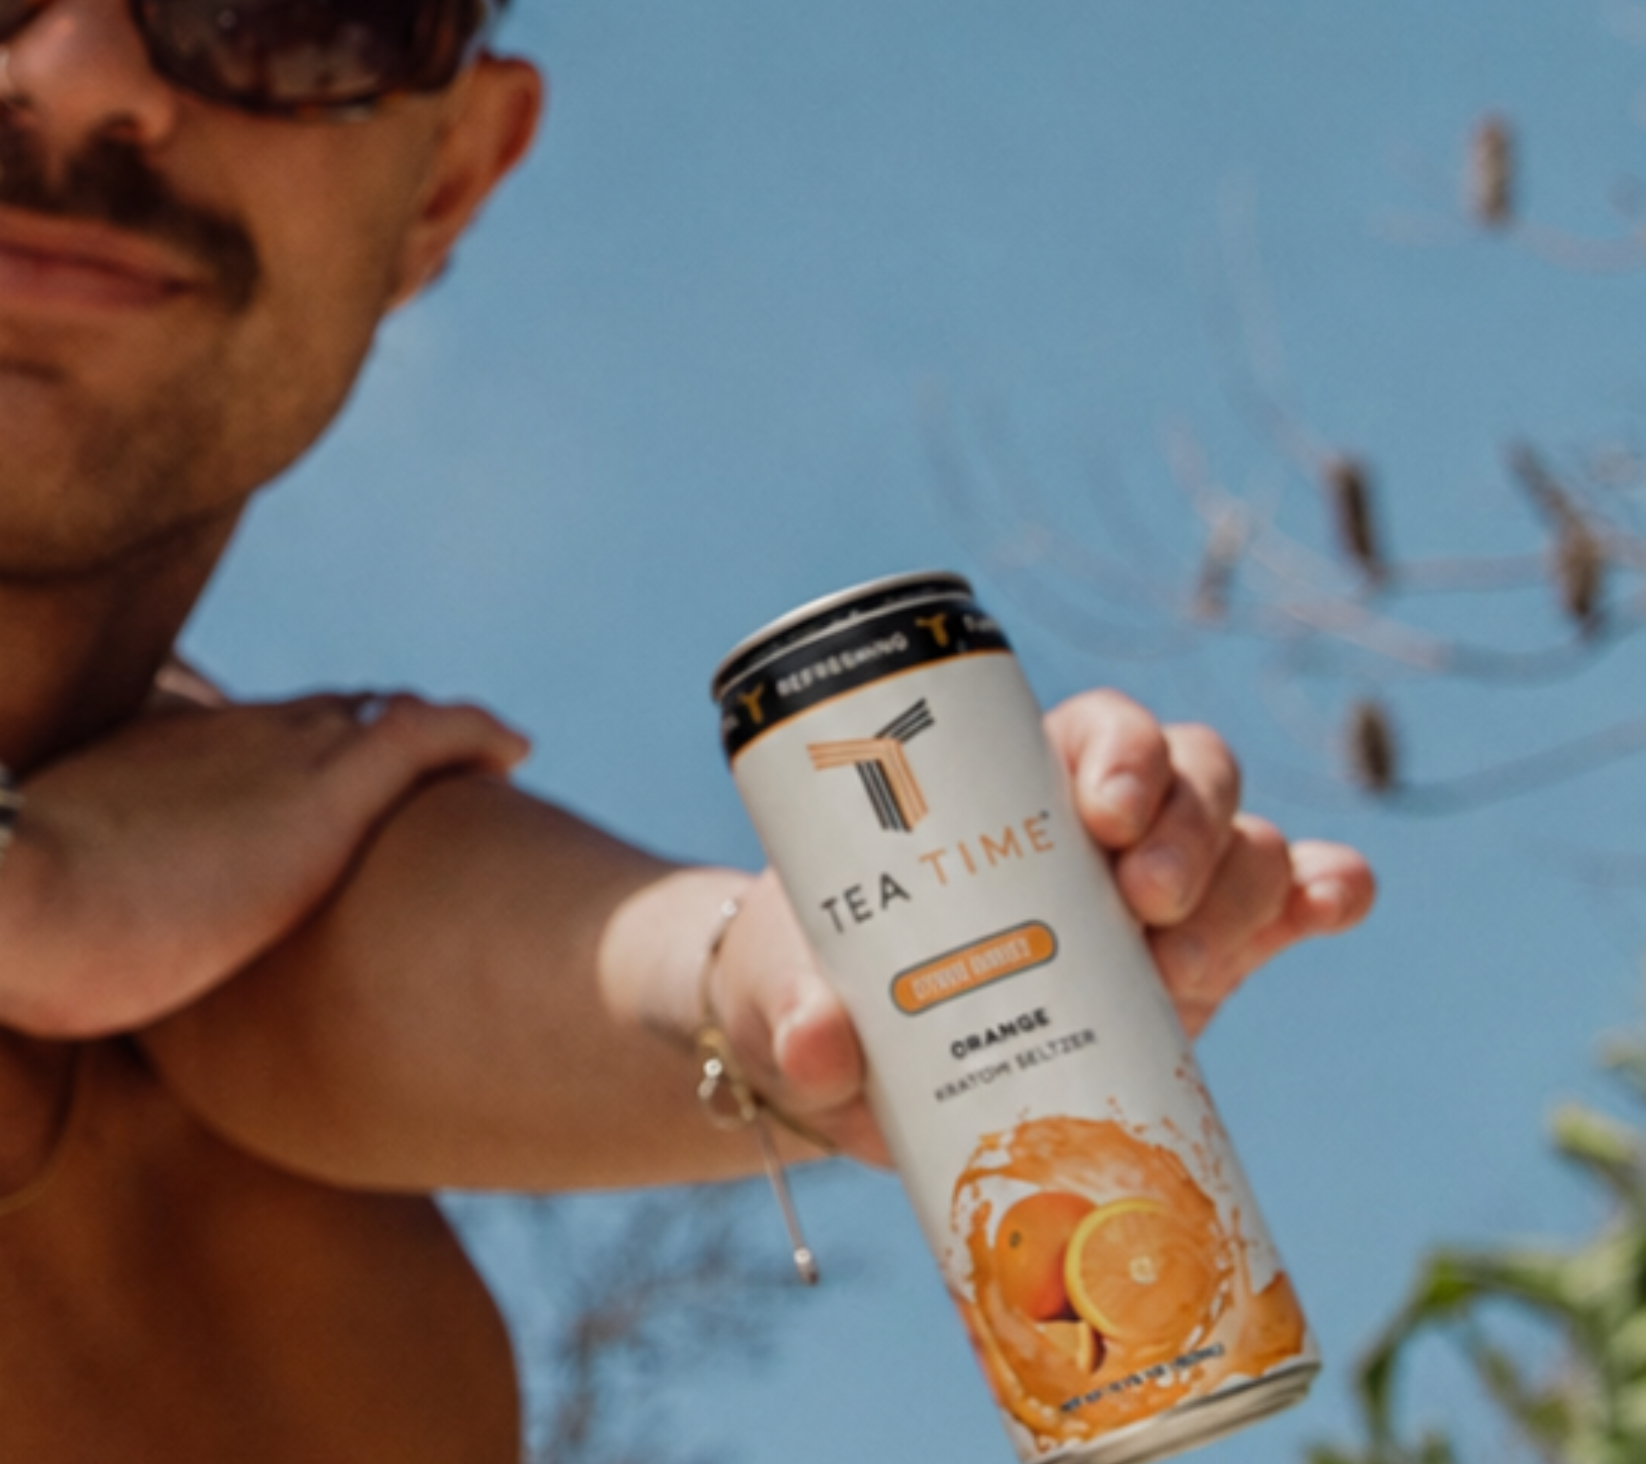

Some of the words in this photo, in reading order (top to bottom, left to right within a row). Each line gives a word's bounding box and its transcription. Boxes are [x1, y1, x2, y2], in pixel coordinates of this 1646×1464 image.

[776, 632, 908, 697] REFRESHING
[820, 872, 911, 934] TEA
[919, 818, 1054, 886] TIME
[935, 1061, 1011, 1102] KRATOM
[1015, 1028, 1096, 1070] SELTZER
[950, 1007, 1049, 1059] ORANGE
